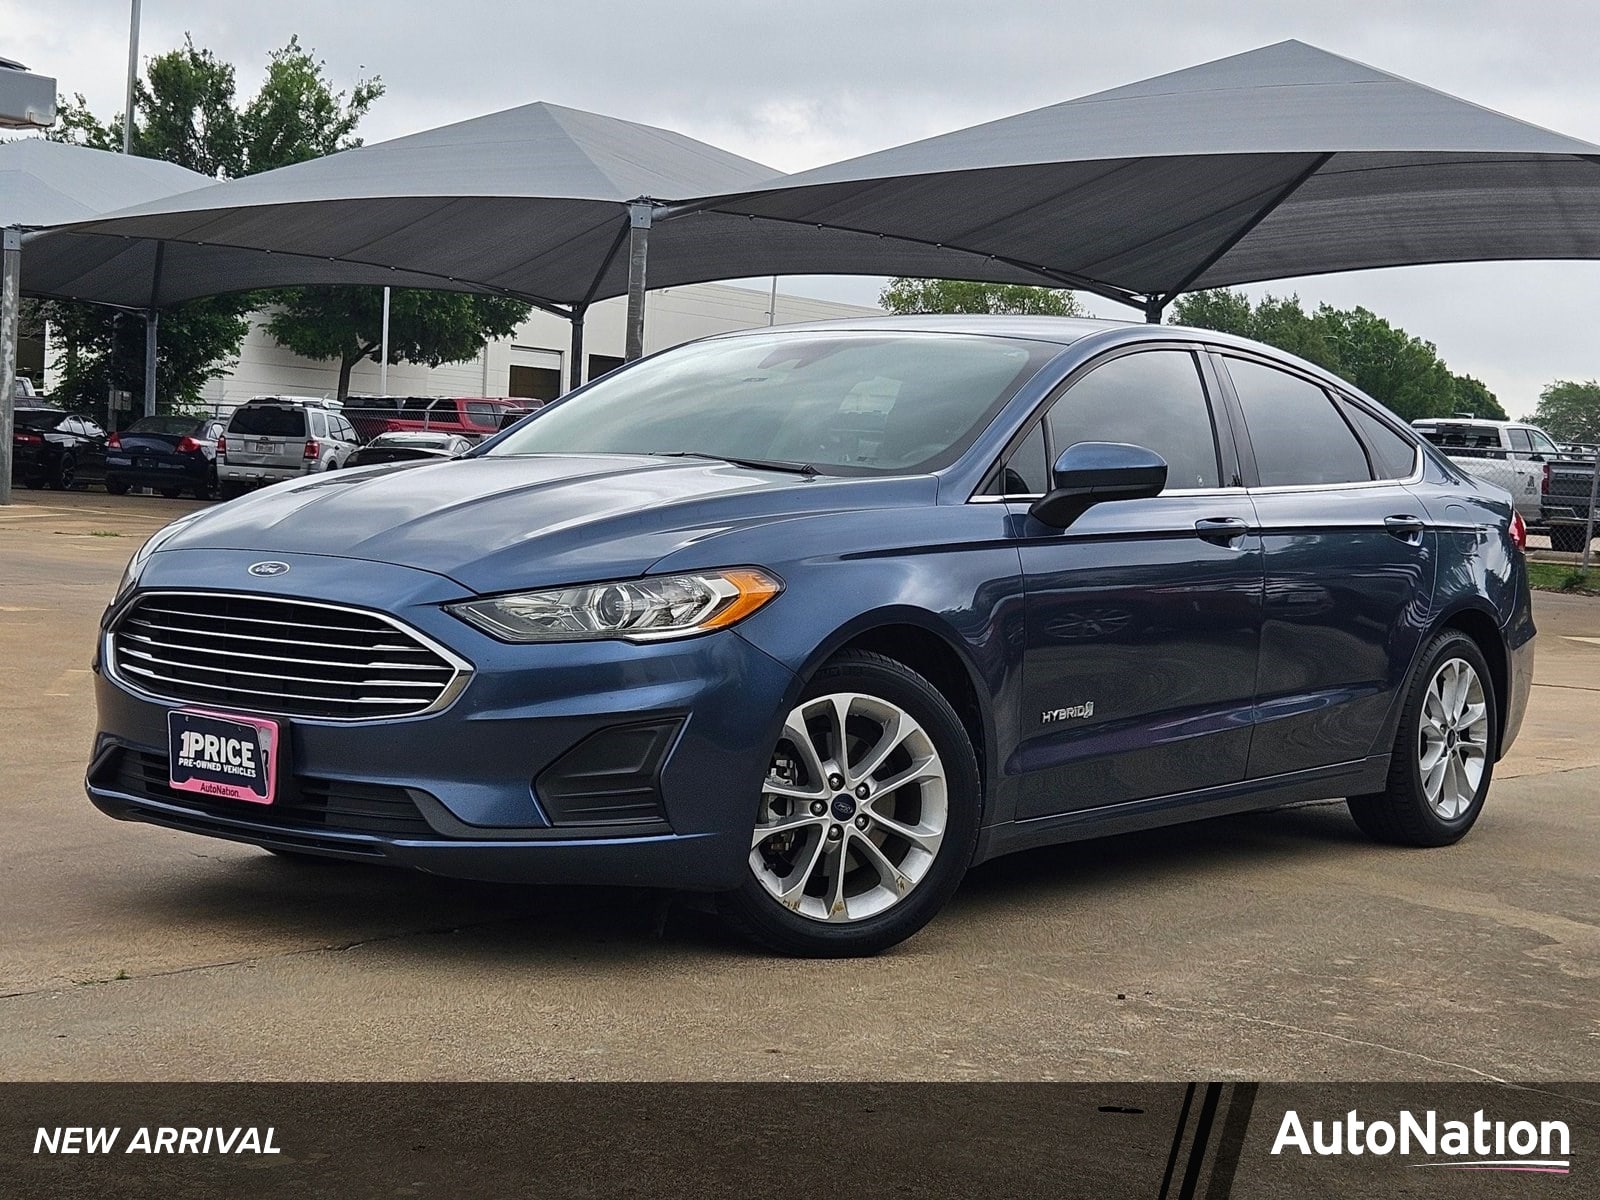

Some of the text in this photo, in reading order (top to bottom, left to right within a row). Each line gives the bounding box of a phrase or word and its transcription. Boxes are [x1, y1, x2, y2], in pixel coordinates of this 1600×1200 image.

[1042, 705, 1085, 723] HYBRID
[179, 731, 255, 769] 1PRICE
[178, 757, 222, 772] PRE-OWNED
[223, 764, 257, 778] VEHICLES
[200, 782, 239, 798] AutoNation
